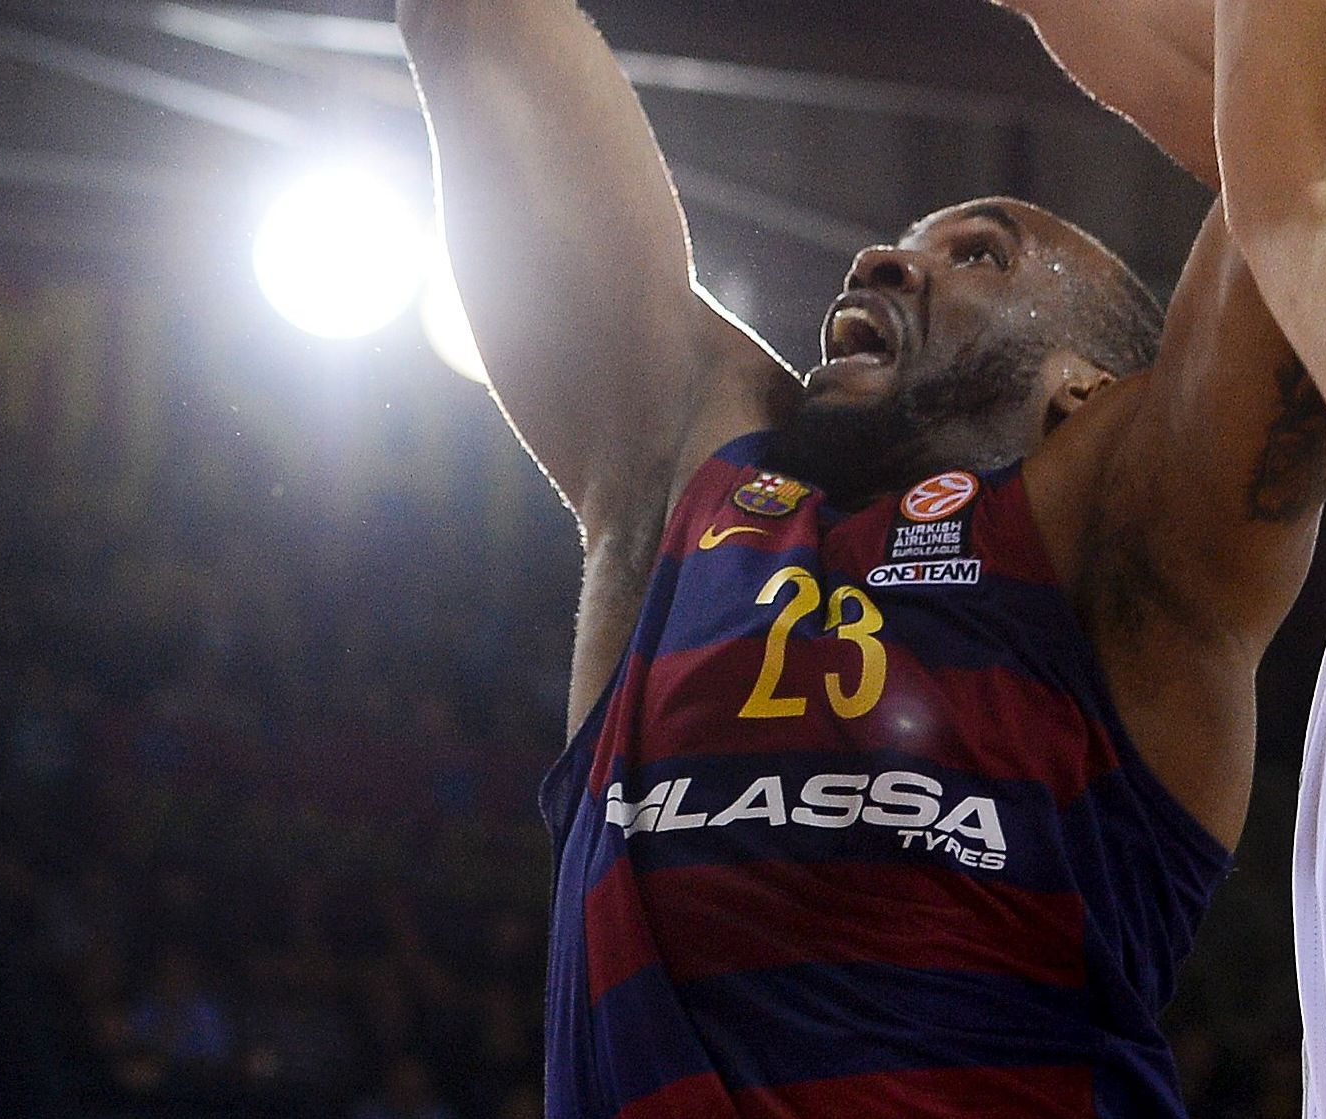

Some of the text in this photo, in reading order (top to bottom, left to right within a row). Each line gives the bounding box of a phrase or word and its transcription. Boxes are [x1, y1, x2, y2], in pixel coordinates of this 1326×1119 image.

[893, 532, 961, 548] AIRLINES
[896, 521, 962, 538] TURKISH
[738, 567, 887, 719] 23
[655, 770, 1007, 852] LASSA
[897, 829, 1007, 870] TYRES
